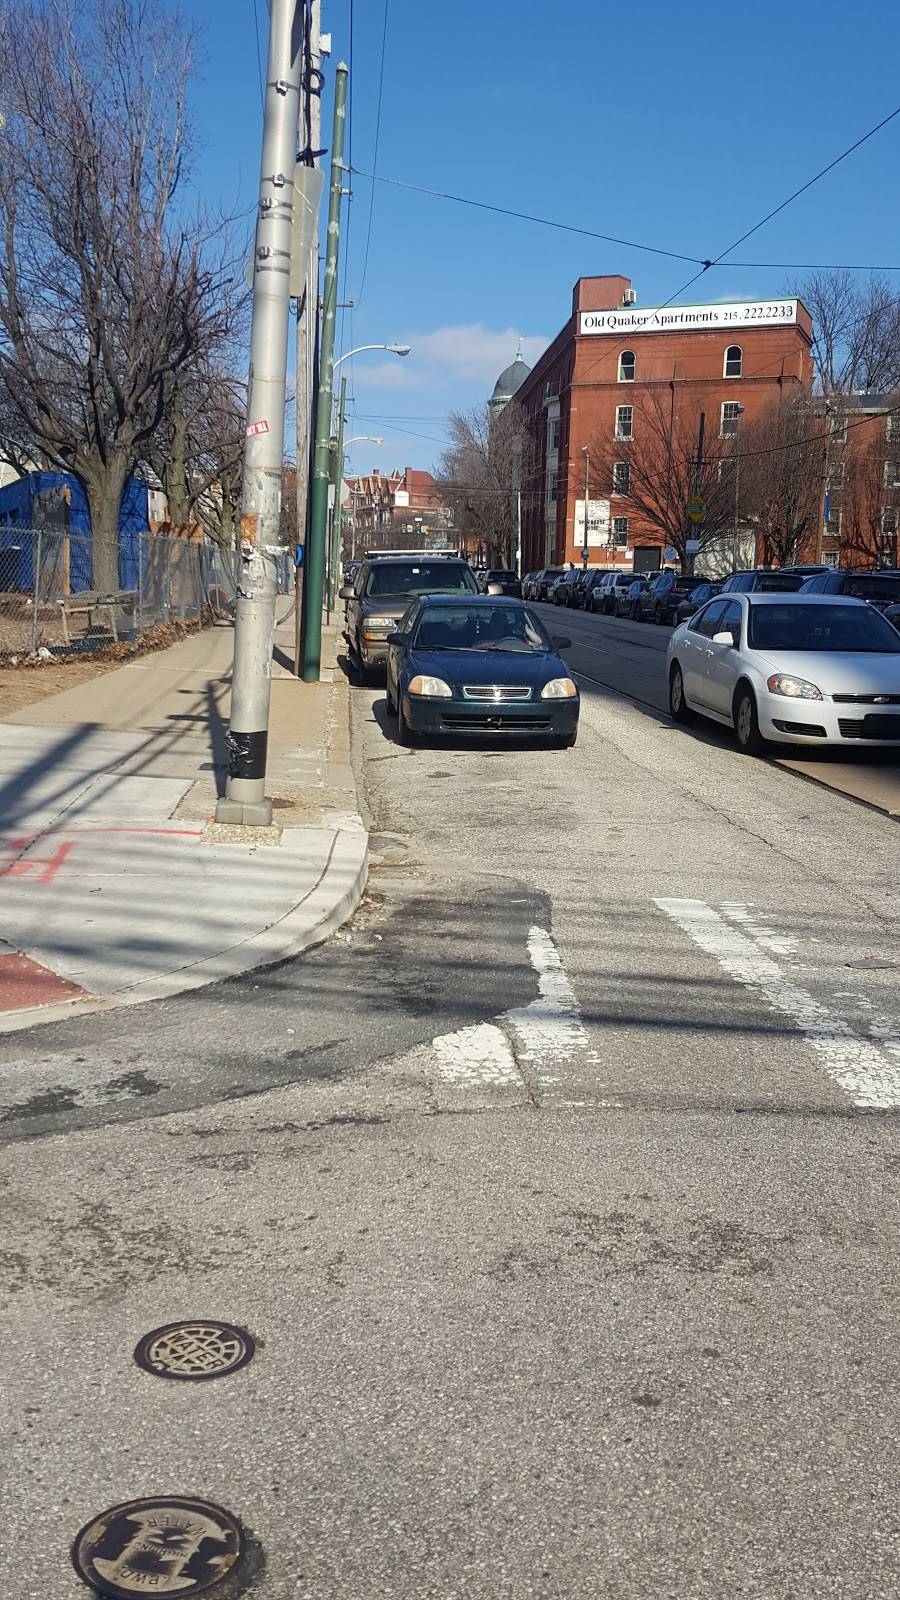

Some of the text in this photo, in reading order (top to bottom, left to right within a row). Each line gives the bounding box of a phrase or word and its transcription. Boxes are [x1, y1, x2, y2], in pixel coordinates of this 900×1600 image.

[584, 314, 605, 329] Old
[607, 313, 650, 329] Quaker
[650, 310, 719, 328] Apartments
[166, 1332, 226, 1370] WATER
[145, 1516, 208, 1538] WATER
